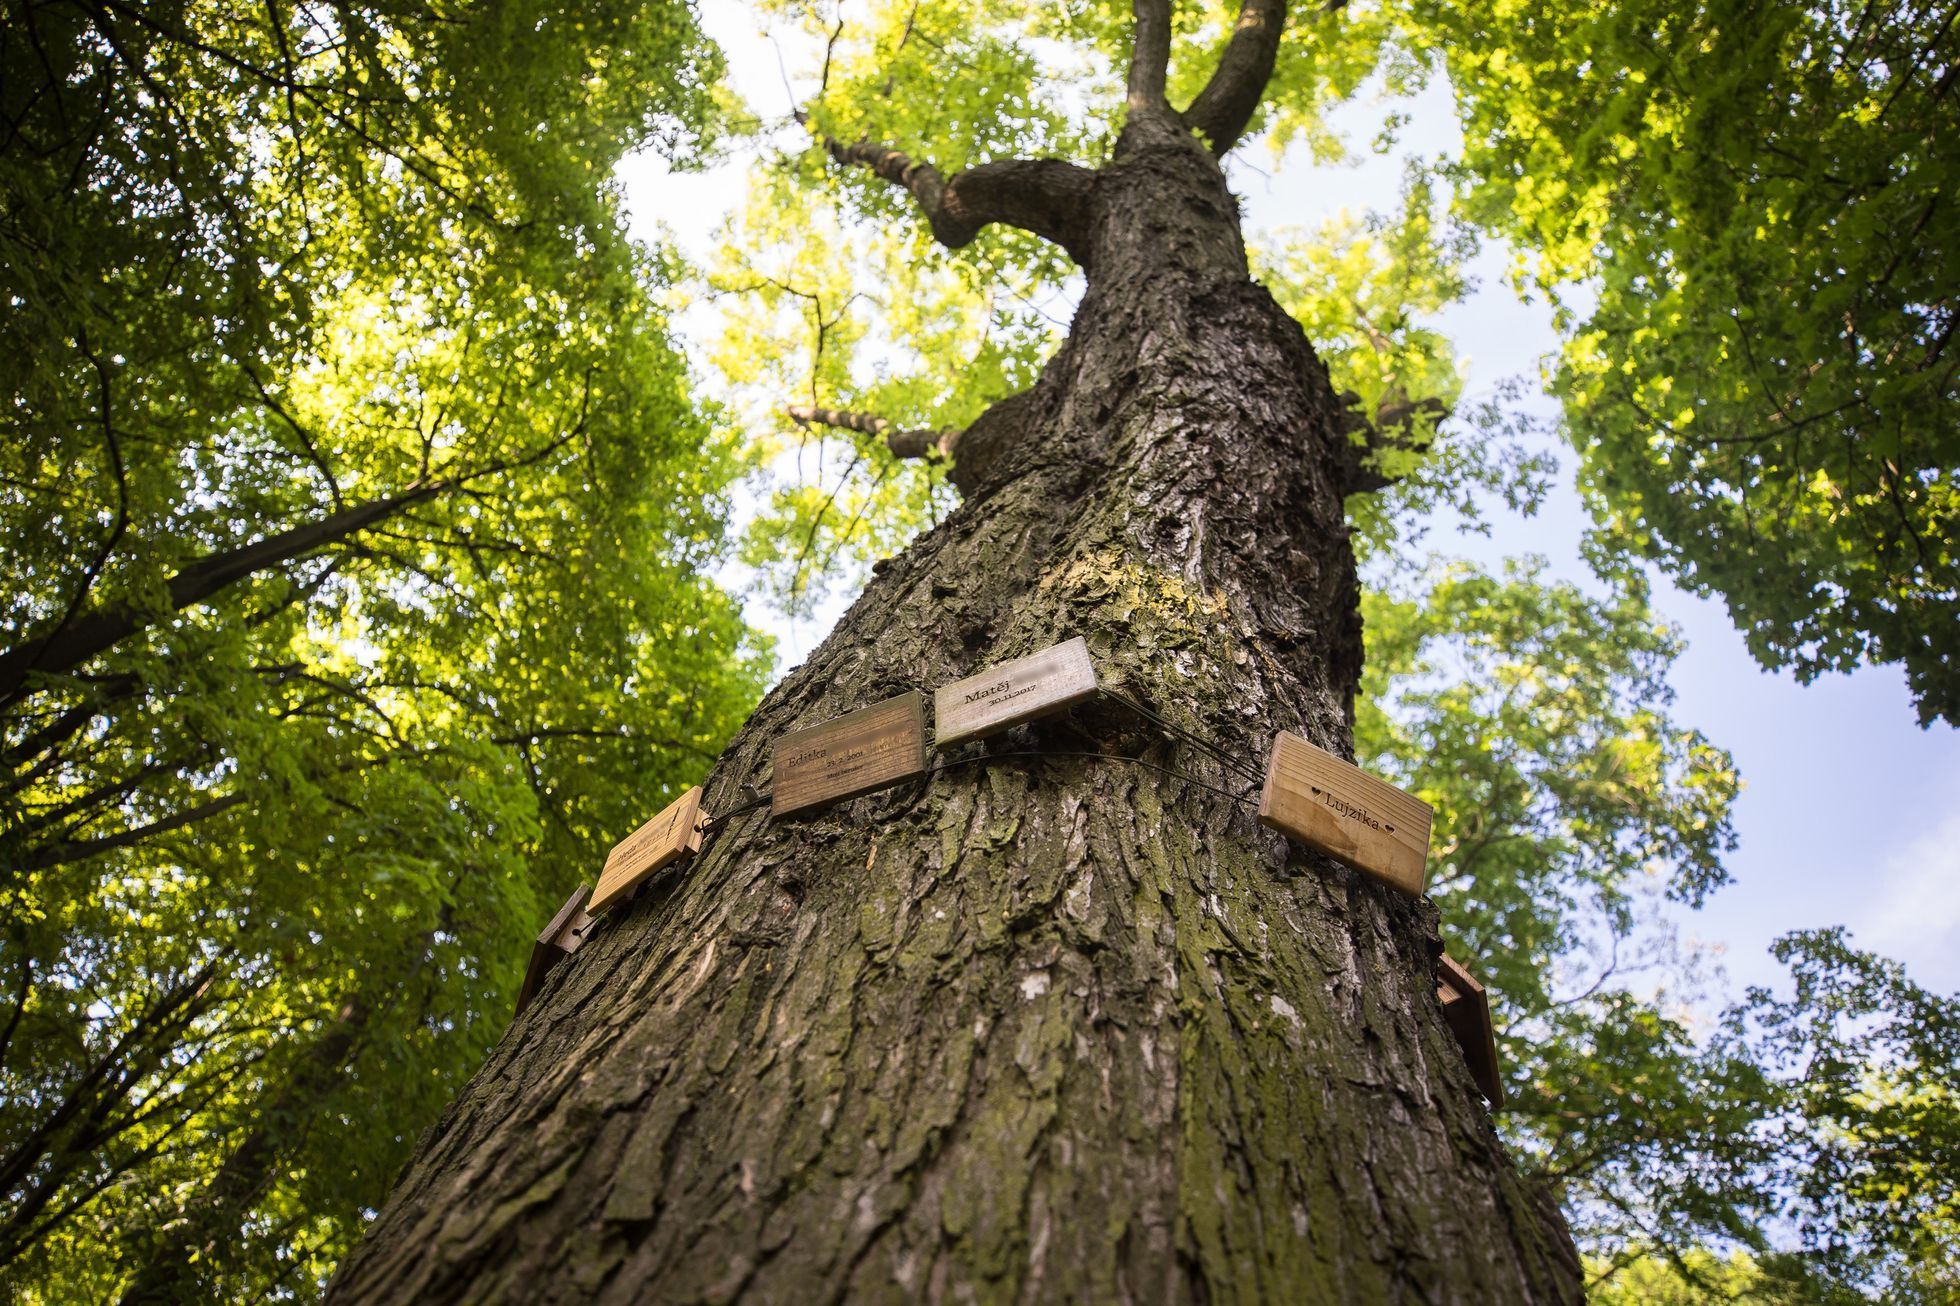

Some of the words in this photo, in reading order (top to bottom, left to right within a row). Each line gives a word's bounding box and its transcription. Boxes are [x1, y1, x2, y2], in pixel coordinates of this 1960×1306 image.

[965, 681, 1010, 704] Matěj
[988, 684, 1037, 706] 30.11.2017
[788, 749, 827, 768] Editka
[1324, 793, 1380, 831] Lujzika
